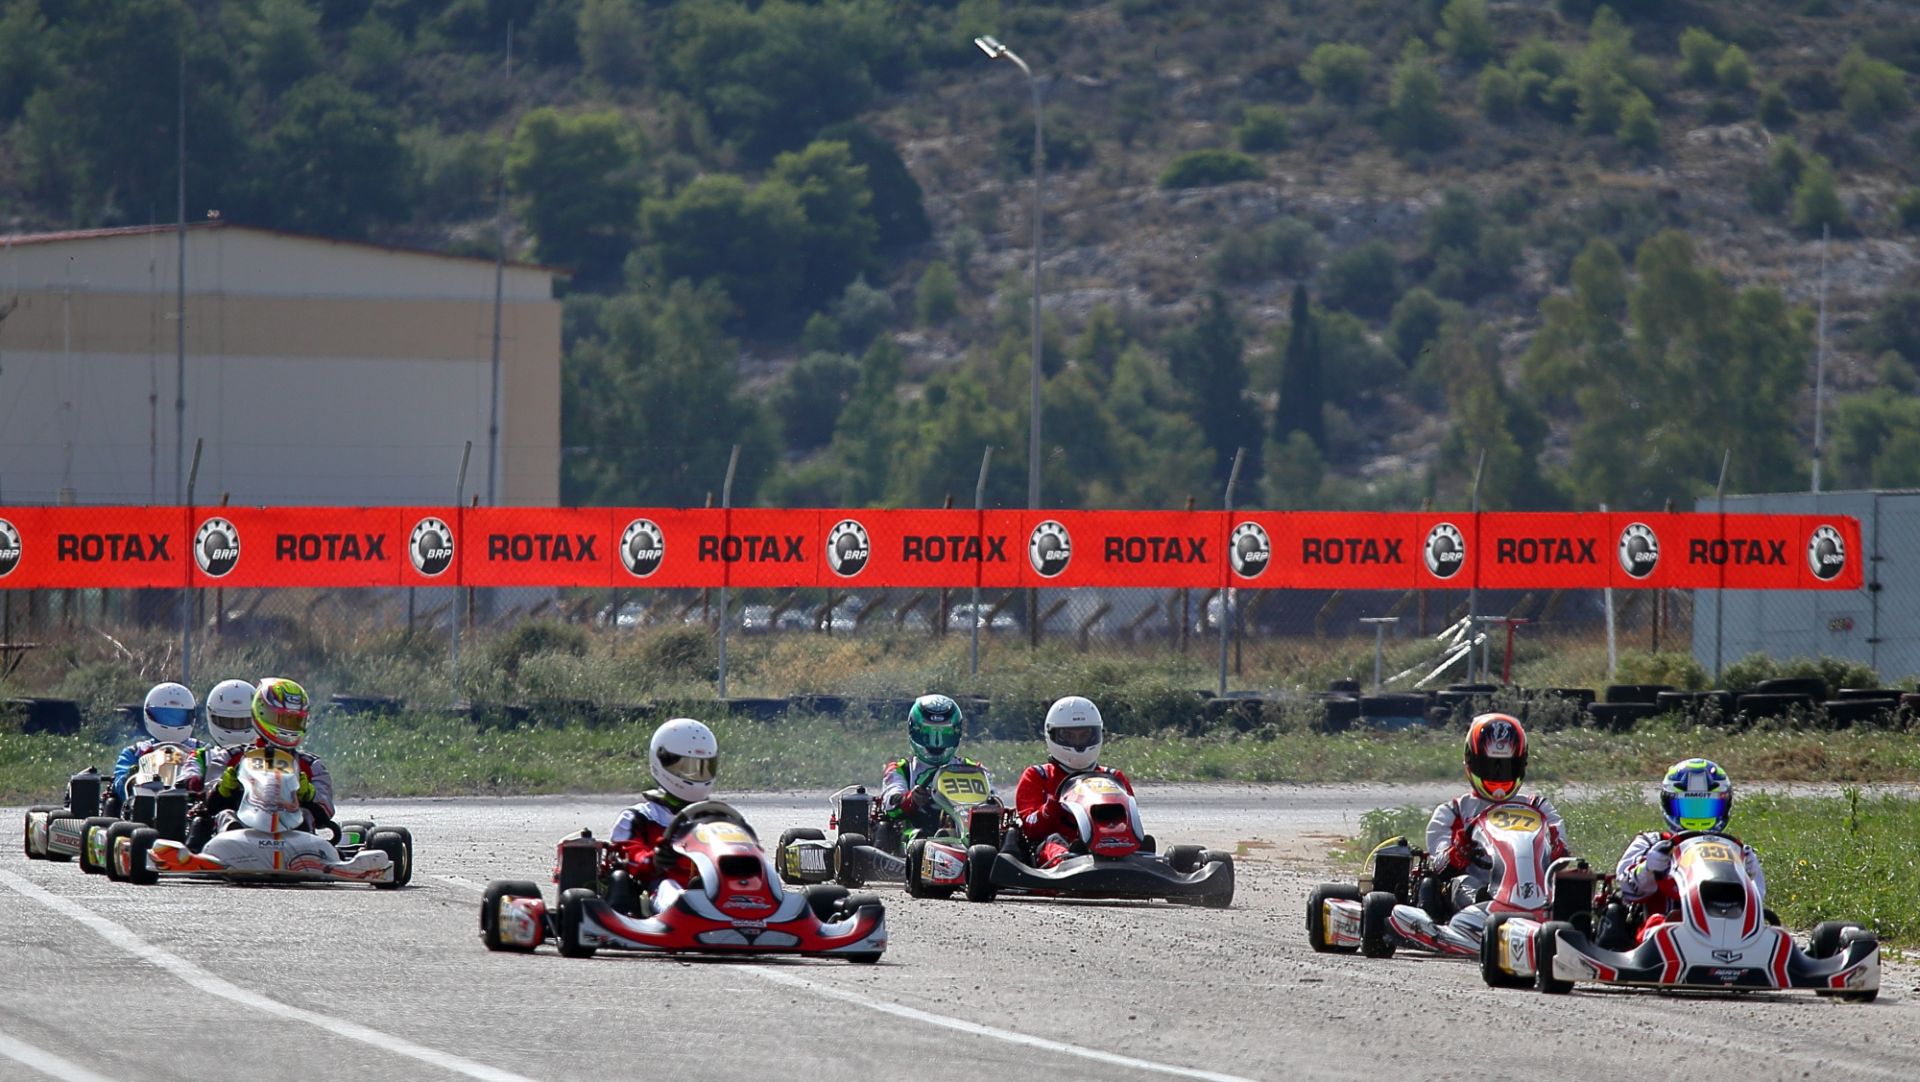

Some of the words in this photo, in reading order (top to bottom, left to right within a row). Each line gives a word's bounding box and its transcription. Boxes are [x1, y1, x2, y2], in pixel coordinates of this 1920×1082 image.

[57, 534, 169, 562] ROTAX
[212, 549, 237, 560] BRP
[275, 534, 385, 561] ROTAX
[427, 549, 451, 559] BRP
[488, 534, 596, 561] ROTAX
[637, 549, 662, 560] BRP
[698, 535, 803, 562] ROTAX
[844, 550, 867, 560] BRP
[902, 536, 1006, 562] ROTAX
[1045, 550, 1069, 560] BRP
[1103, 537, 1206, 563] ROTAX
[1244, 551, 1268, 561] BRP
[1302, 538, 1402, 564] ROTAX
[1439, 551, 1462, 561] BRP
[1497, 538, 1596, 564] ROTAX
[1635, 551, 1657, 562] BRP
[1689, 538, 1786, 565] ROTAX
[1822, 553, 1844, 564] BRP
[942, 777, 987, 795] 330
[1492, 810, 1536, 828] 377
